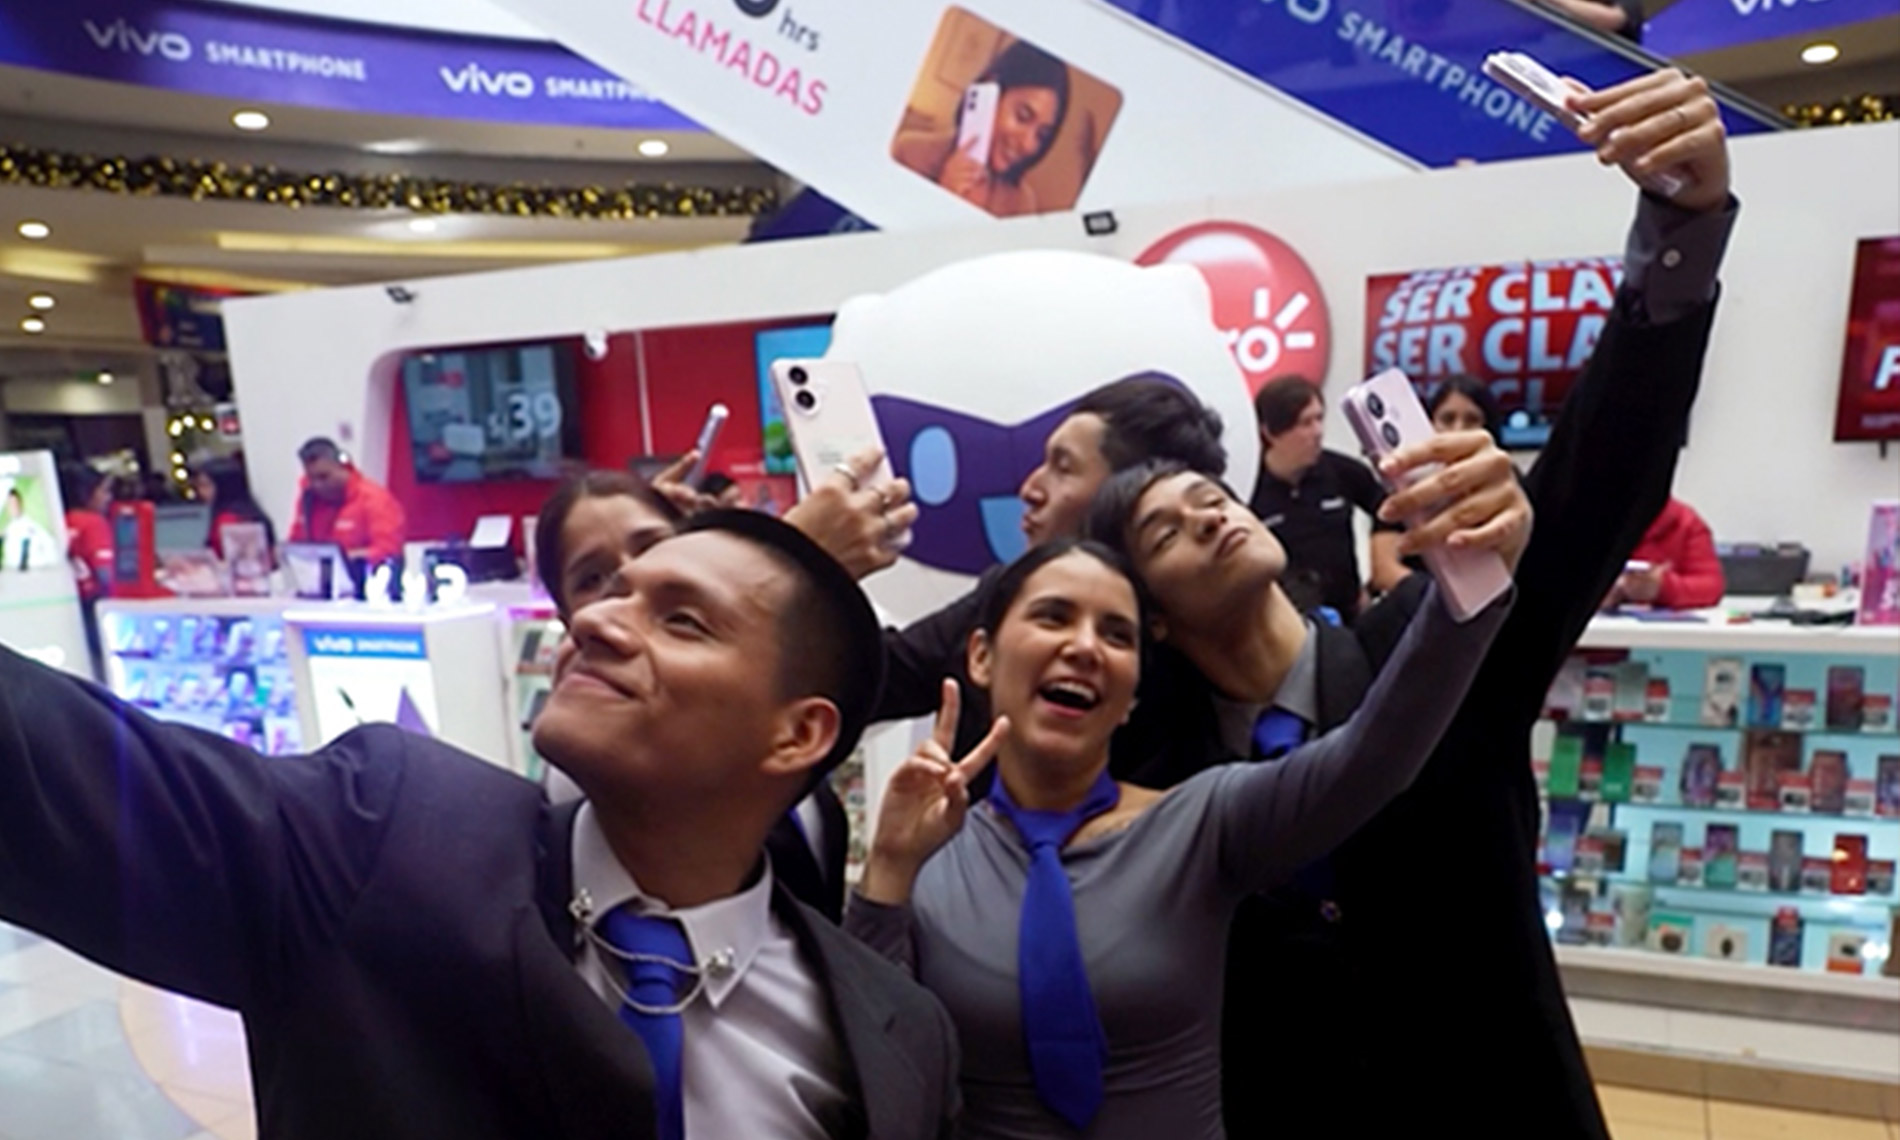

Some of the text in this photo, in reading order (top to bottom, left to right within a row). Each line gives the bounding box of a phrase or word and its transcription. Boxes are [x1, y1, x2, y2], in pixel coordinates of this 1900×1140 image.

[84, 18, 367, 81] vivo SMARTPHONE
[778, 7, 820, 51] hrs
[439, 62, 535, 98] vivo
[637, 0, 828, 115] LLAMADAS
[1337, 11, 1556, 142] SMARTPHONE
[1378, 276, 1477, 328] SER
[1373, 323, 1467, 376] SER
[508, 392, 562, 438] 39
